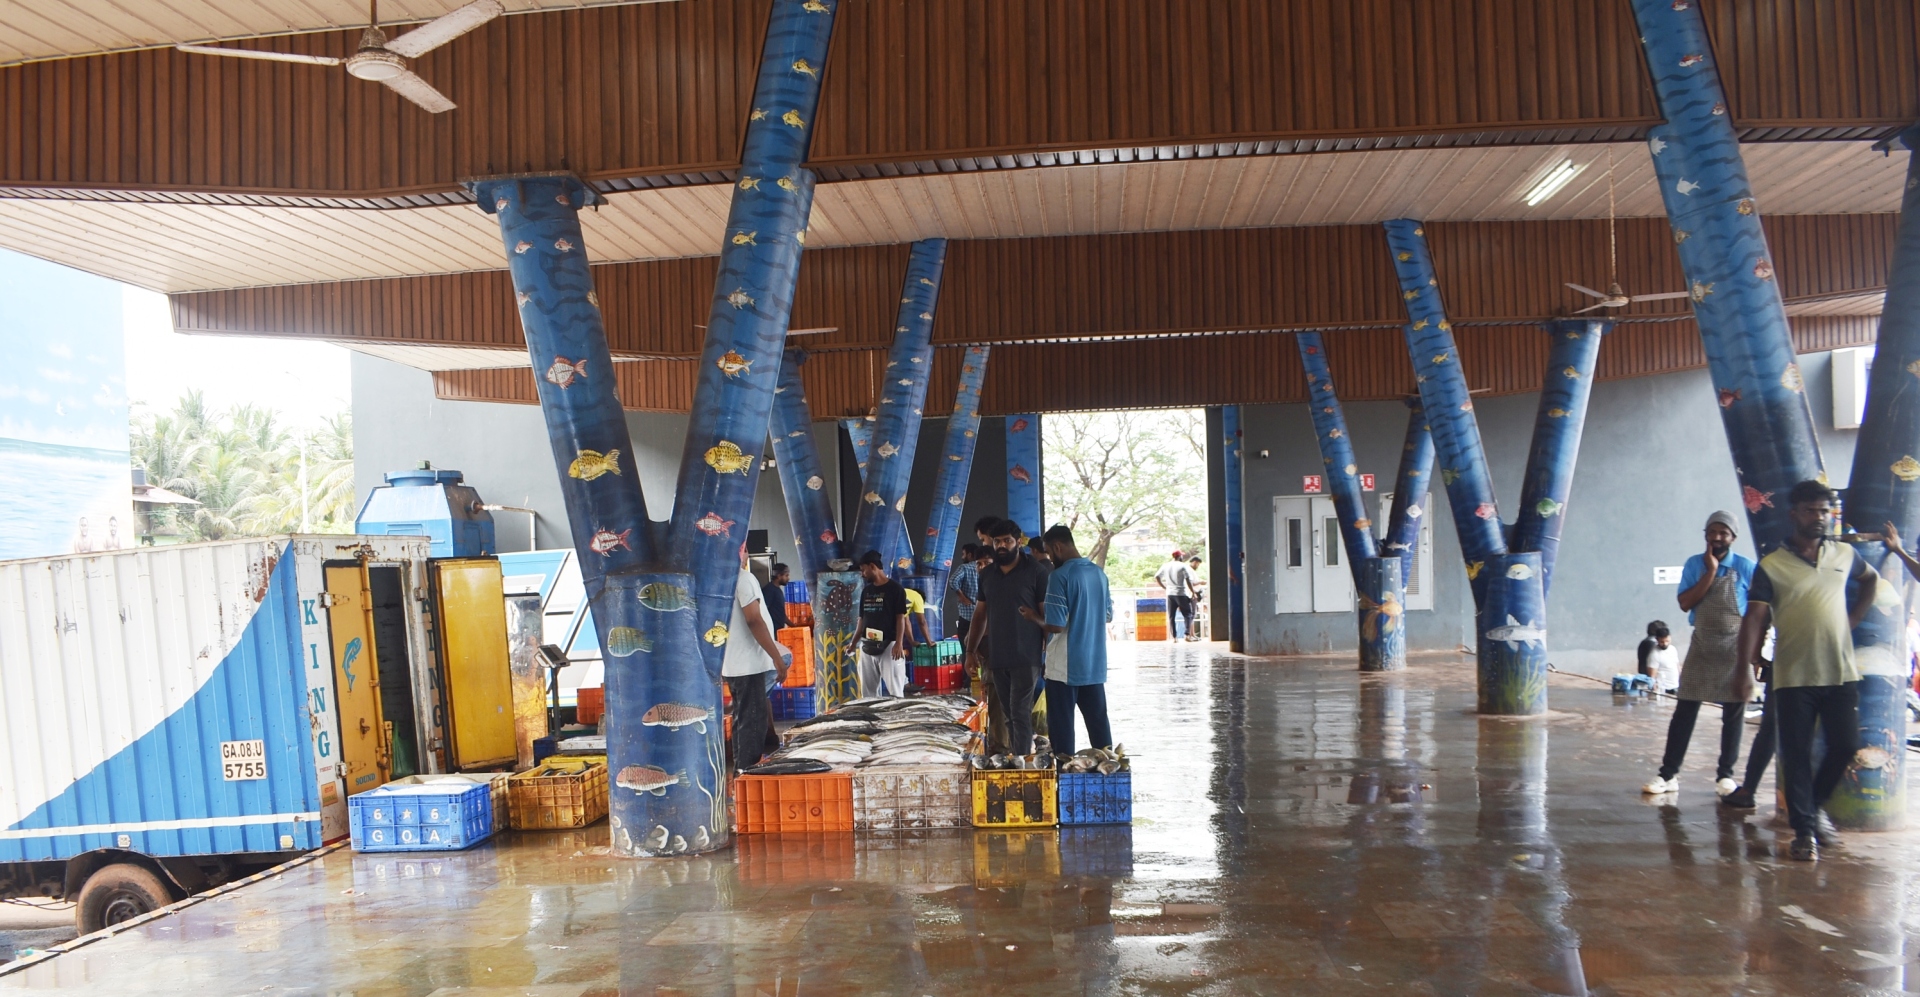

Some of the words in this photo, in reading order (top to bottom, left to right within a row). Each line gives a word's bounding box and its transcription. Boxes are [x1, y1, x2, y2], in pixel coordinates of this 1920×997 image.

[302, 599, 331, 758] KING
[225, 762, 264, 778] 5755
[355, 773, 376, 786] SOUND
[371, 829, 440, 842] GOA
